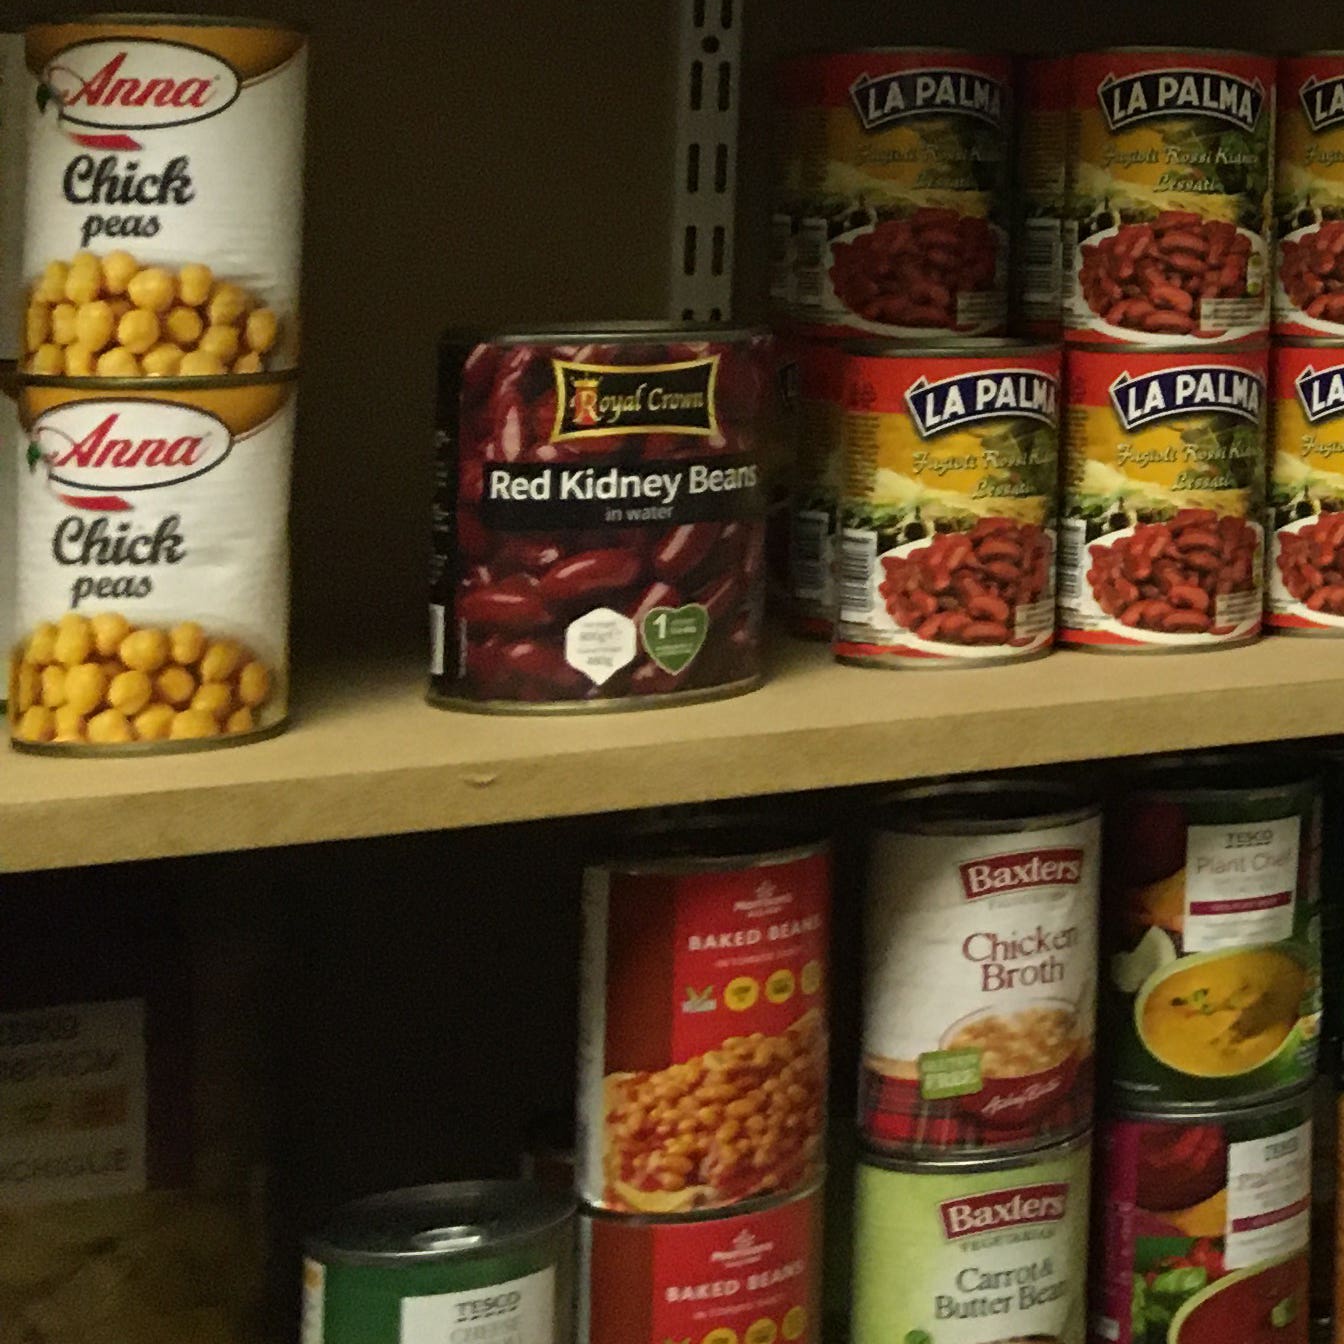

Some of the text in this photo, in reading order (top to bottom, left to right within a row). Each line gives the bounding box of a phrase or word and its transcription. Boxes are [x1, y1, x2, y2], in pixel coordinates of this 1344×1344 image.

[62, 51, 214, 108] Anna
[1111, 74, 1257, 123] LA PALMA
[867, 80, 904, 120] LA
[62, 154, 196, 206] Chick
[80, 214, 162, 249] peas
[647, 387, 705, 411] Crown
[922, 387, 965, 429] LA
[1126, 371, 1260, 422] LA PALMA
[47, 413, 211, 468] Anna
[489, 463, 758, 504] Red Kidney Beans
[604, 505, 674, 522] in water
[52, 513, 189, 566] Chick
[71, 574, 154, 609] peas
[968, 857, 1080, 895] Baxters
[688, 912, 823, 953] BAKED BEANS
[981, 958, 1066, 993] Broth
[947, 1194, 1066, 1234] Baxters
[665, 1279, 741, 1304] BAKED
